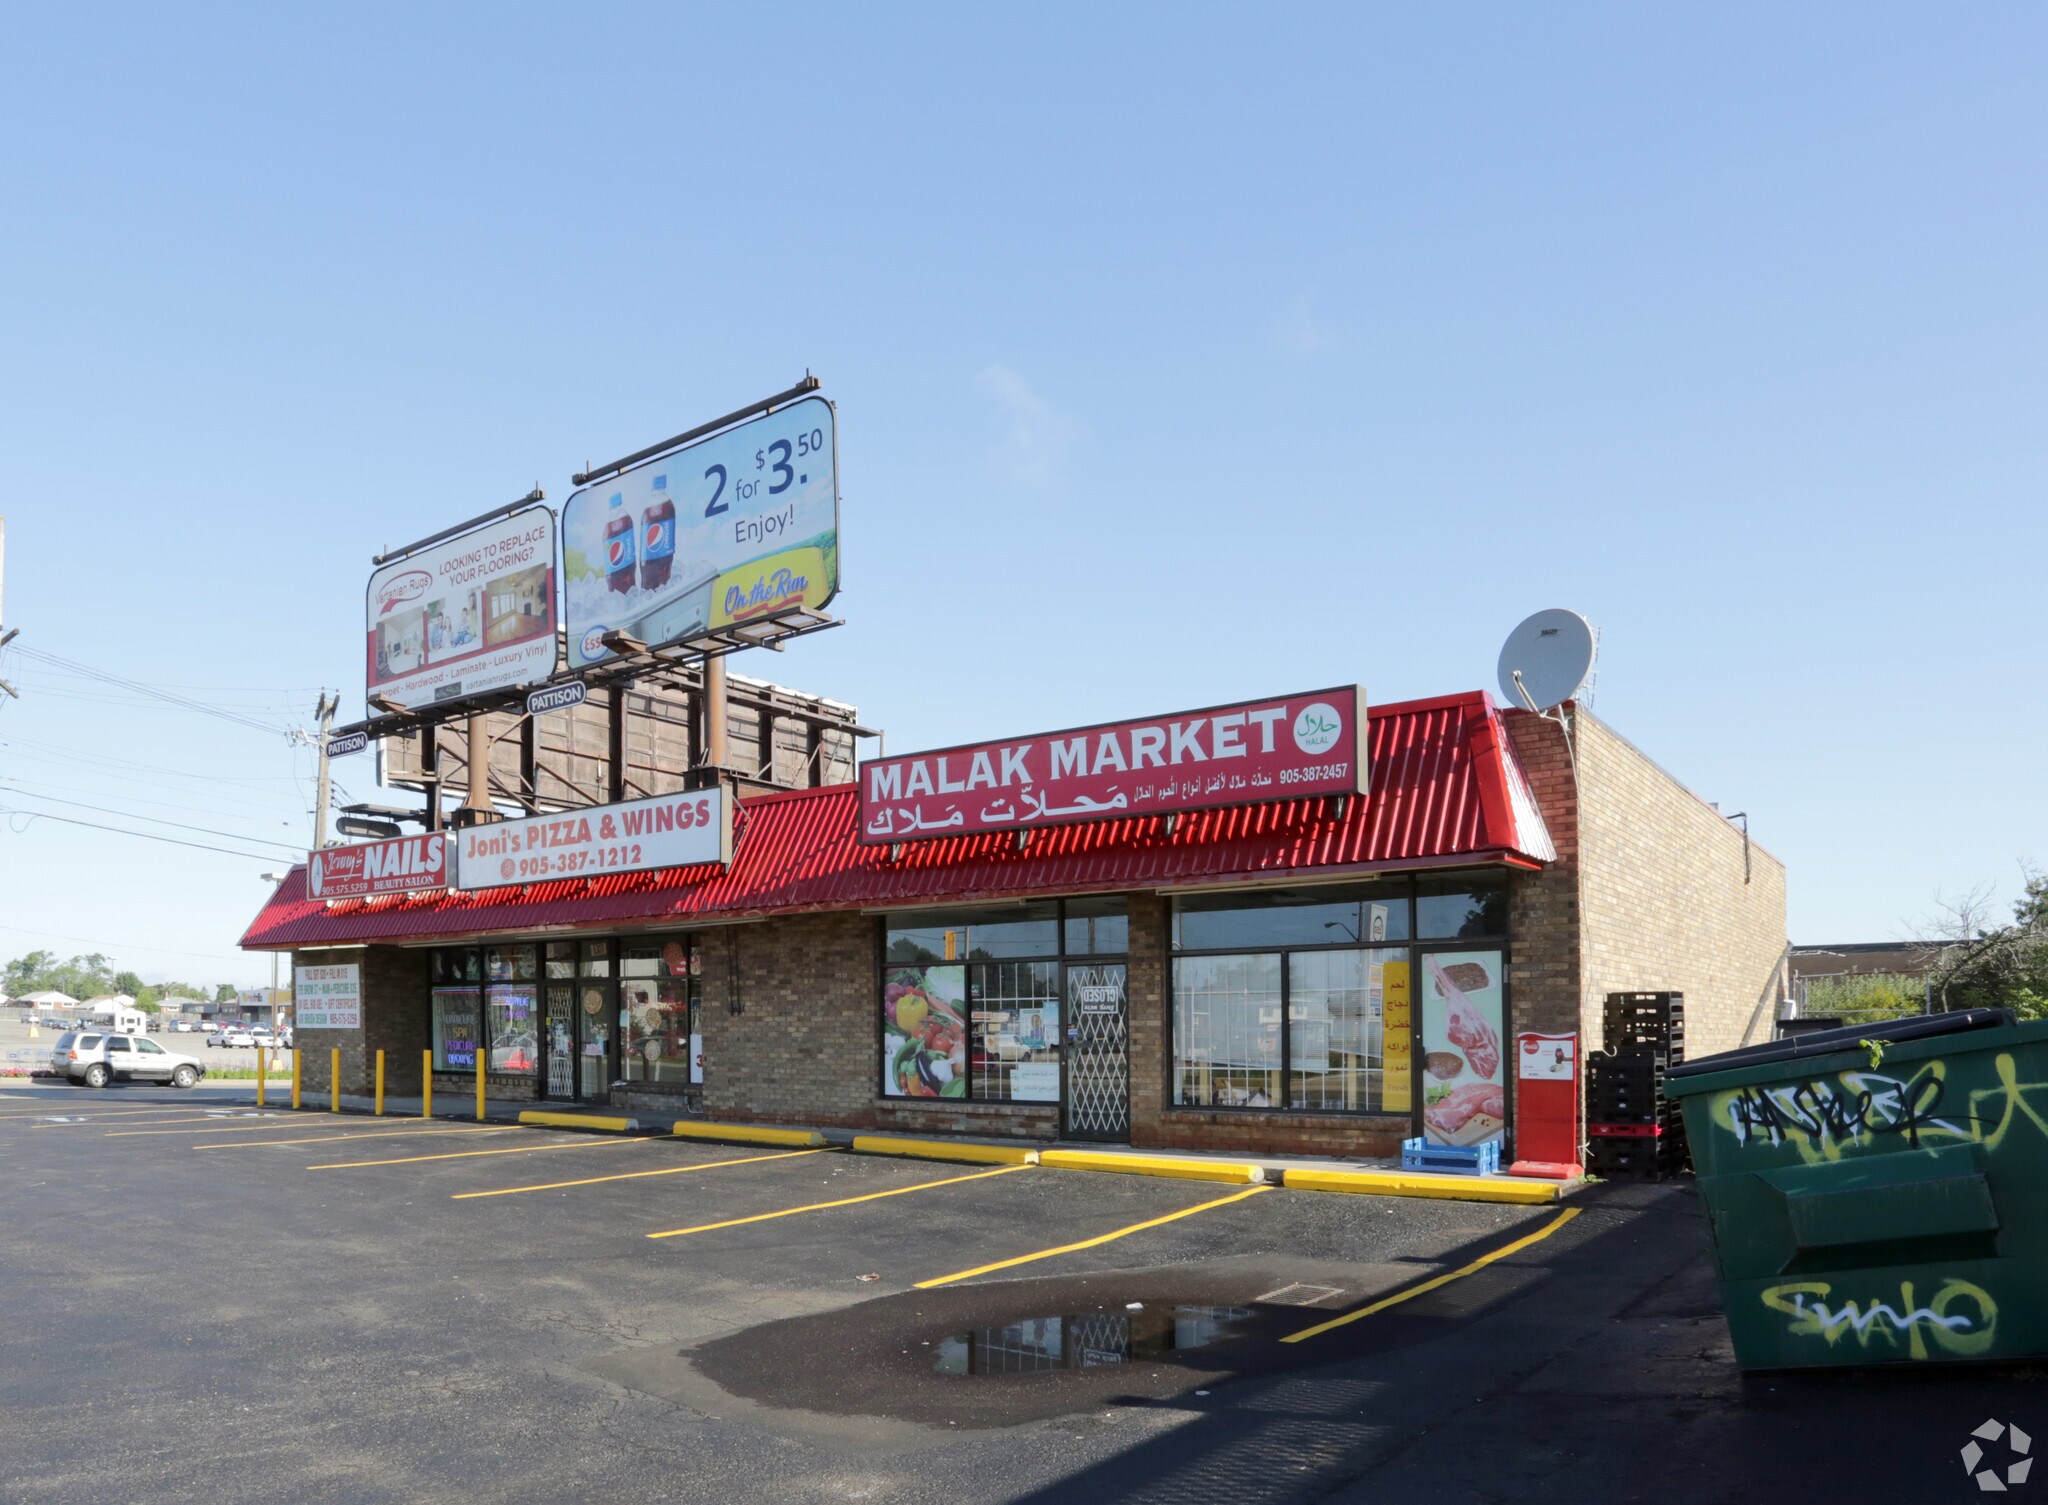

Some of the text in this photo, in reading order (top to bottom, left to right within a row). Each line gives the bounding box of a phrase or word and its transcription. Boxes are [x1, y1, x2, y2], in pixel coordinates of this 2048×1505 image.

[704, 463, 729, 519] 2
[735, 480, 760, 502] for
[735, 504, 794, 544] Enjoy!
[439, 526, 546, 576] LOOKING TO REPLACE
[449, 547, 534, 587] YOUR FLOORING?
[374, 575, 429, 606] Vartanian Rugs
[770, 567, 809, 599] Run
[405, 672, 444, 692] Hardwood
[451, 661, 487, 679] Laminate
[494, 650, 523, 667] Luxury
[526, 642, 548, 658] Vinyl
[466, 668, 529, 691] vartanianrugs.com
[531, 685, 582, 711] PATTISON
[1297, 713, 1338, 737] حلال
[327, 735, 366, 756] PATTISON
[870, 704, 1287, 803] MALAK MARKET
[1305, 736, 1329, 746] HALAL
[1279, 763, 1348, 785] 905-387-2457
[467, 799, 711, 859] Joni's PIZZA & WINGS
[324, 836, 444, 882] Jenny's NAILS
[519, 844, 642, 877] 905-387-1212
[321, 882, 368, 895] 905.575.5259
[373, 875, 435, 891] BEAUTY SALON
[1083, 988, 1116, 1003] CLOSED
[453, 1026, 468, 1039] SPA
